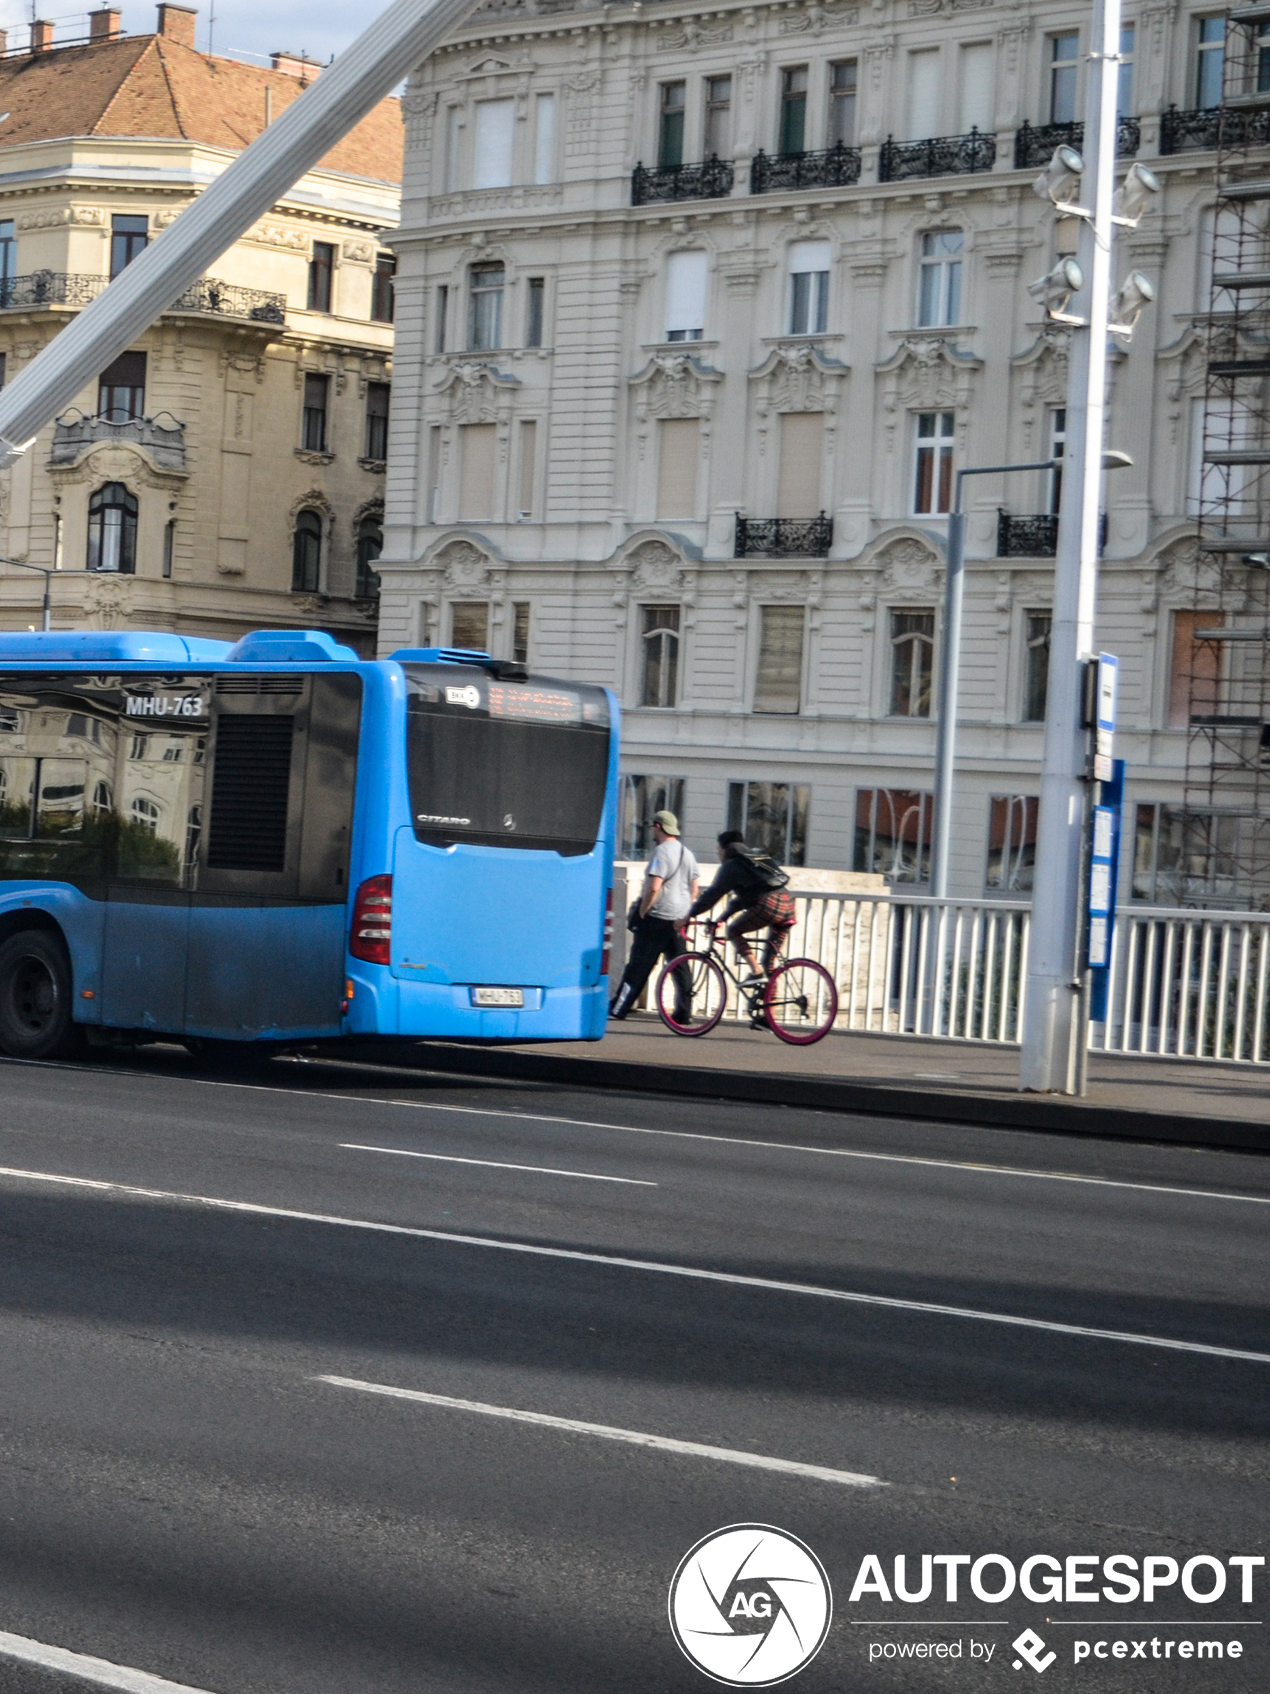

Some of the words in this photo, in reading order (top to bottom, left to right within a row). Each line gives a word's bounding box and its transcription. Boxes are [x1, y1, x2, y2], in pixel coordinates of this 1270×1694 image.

[126, 697, 203, 716] MHU-763
[416, 814, 471, 825] CITARO
[478, 989, 521, 1003] MHU-763
